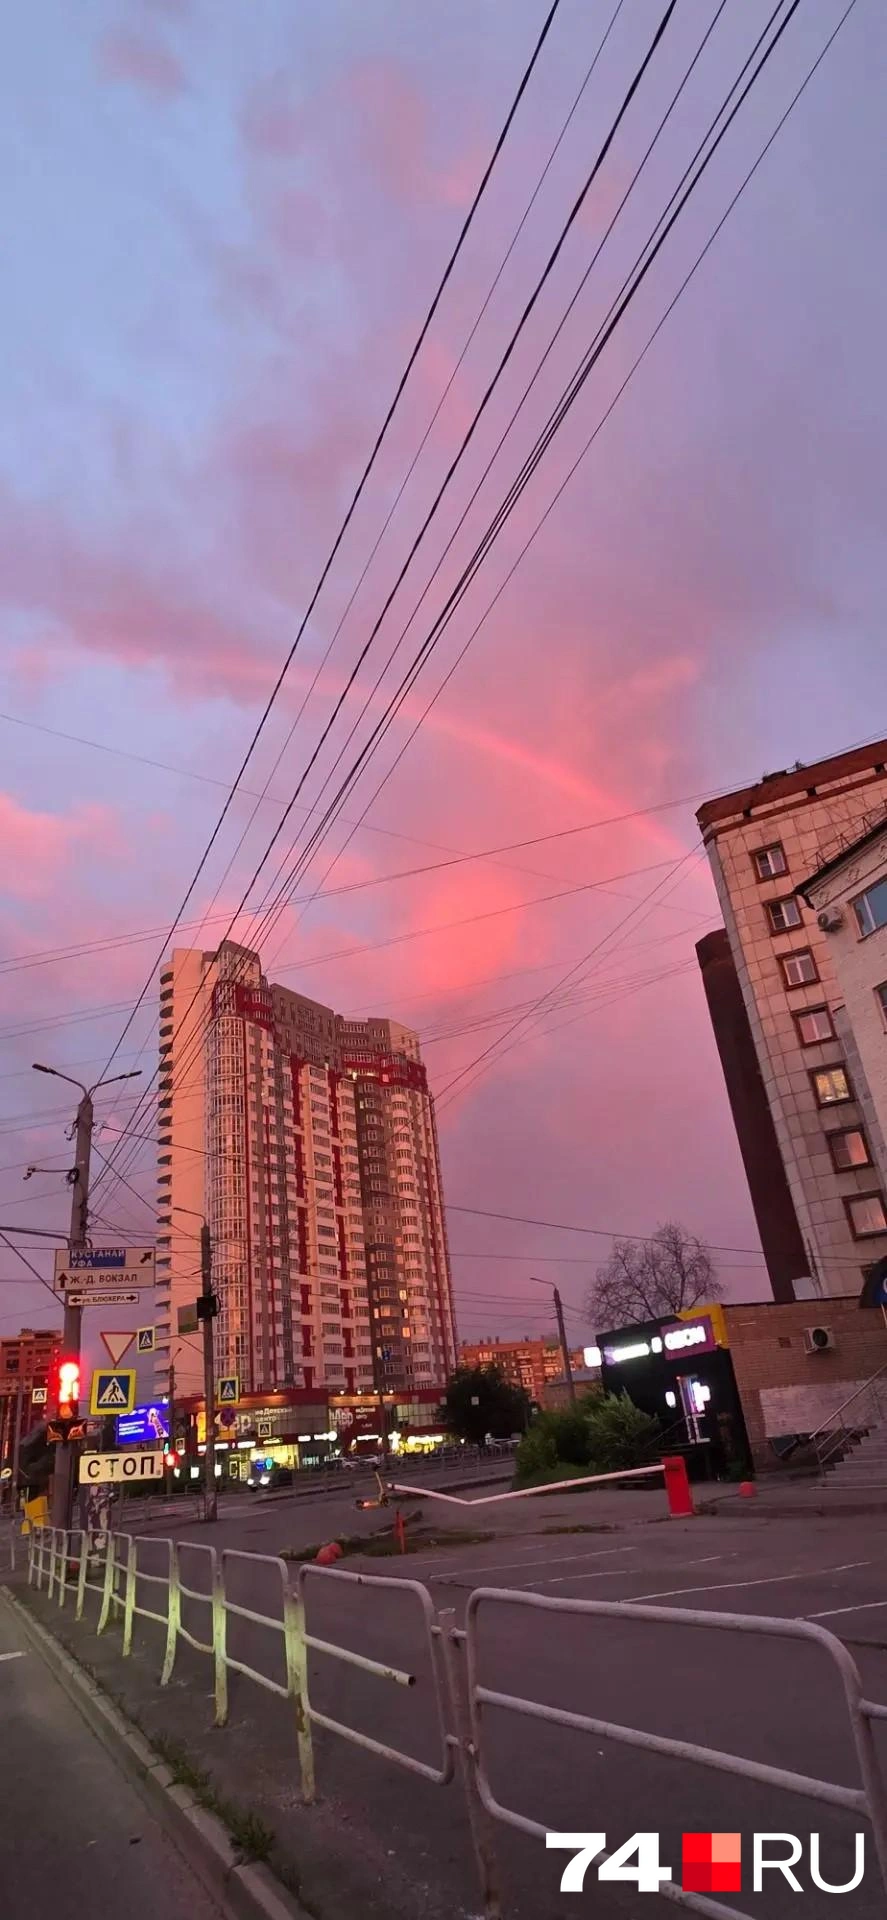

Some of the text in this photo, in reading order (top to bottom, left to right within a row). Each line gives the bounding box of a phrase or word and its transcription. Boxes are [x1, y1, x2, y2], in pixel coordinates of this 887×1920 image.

[71, 1259, 93, 1267] УФА
[99, 1273, 138, 1283] ВОКЗАЛ
[92, 1295, 126, 1303] БЛЮХЕРА
[87, 1455, 155, 1478] СТОП
